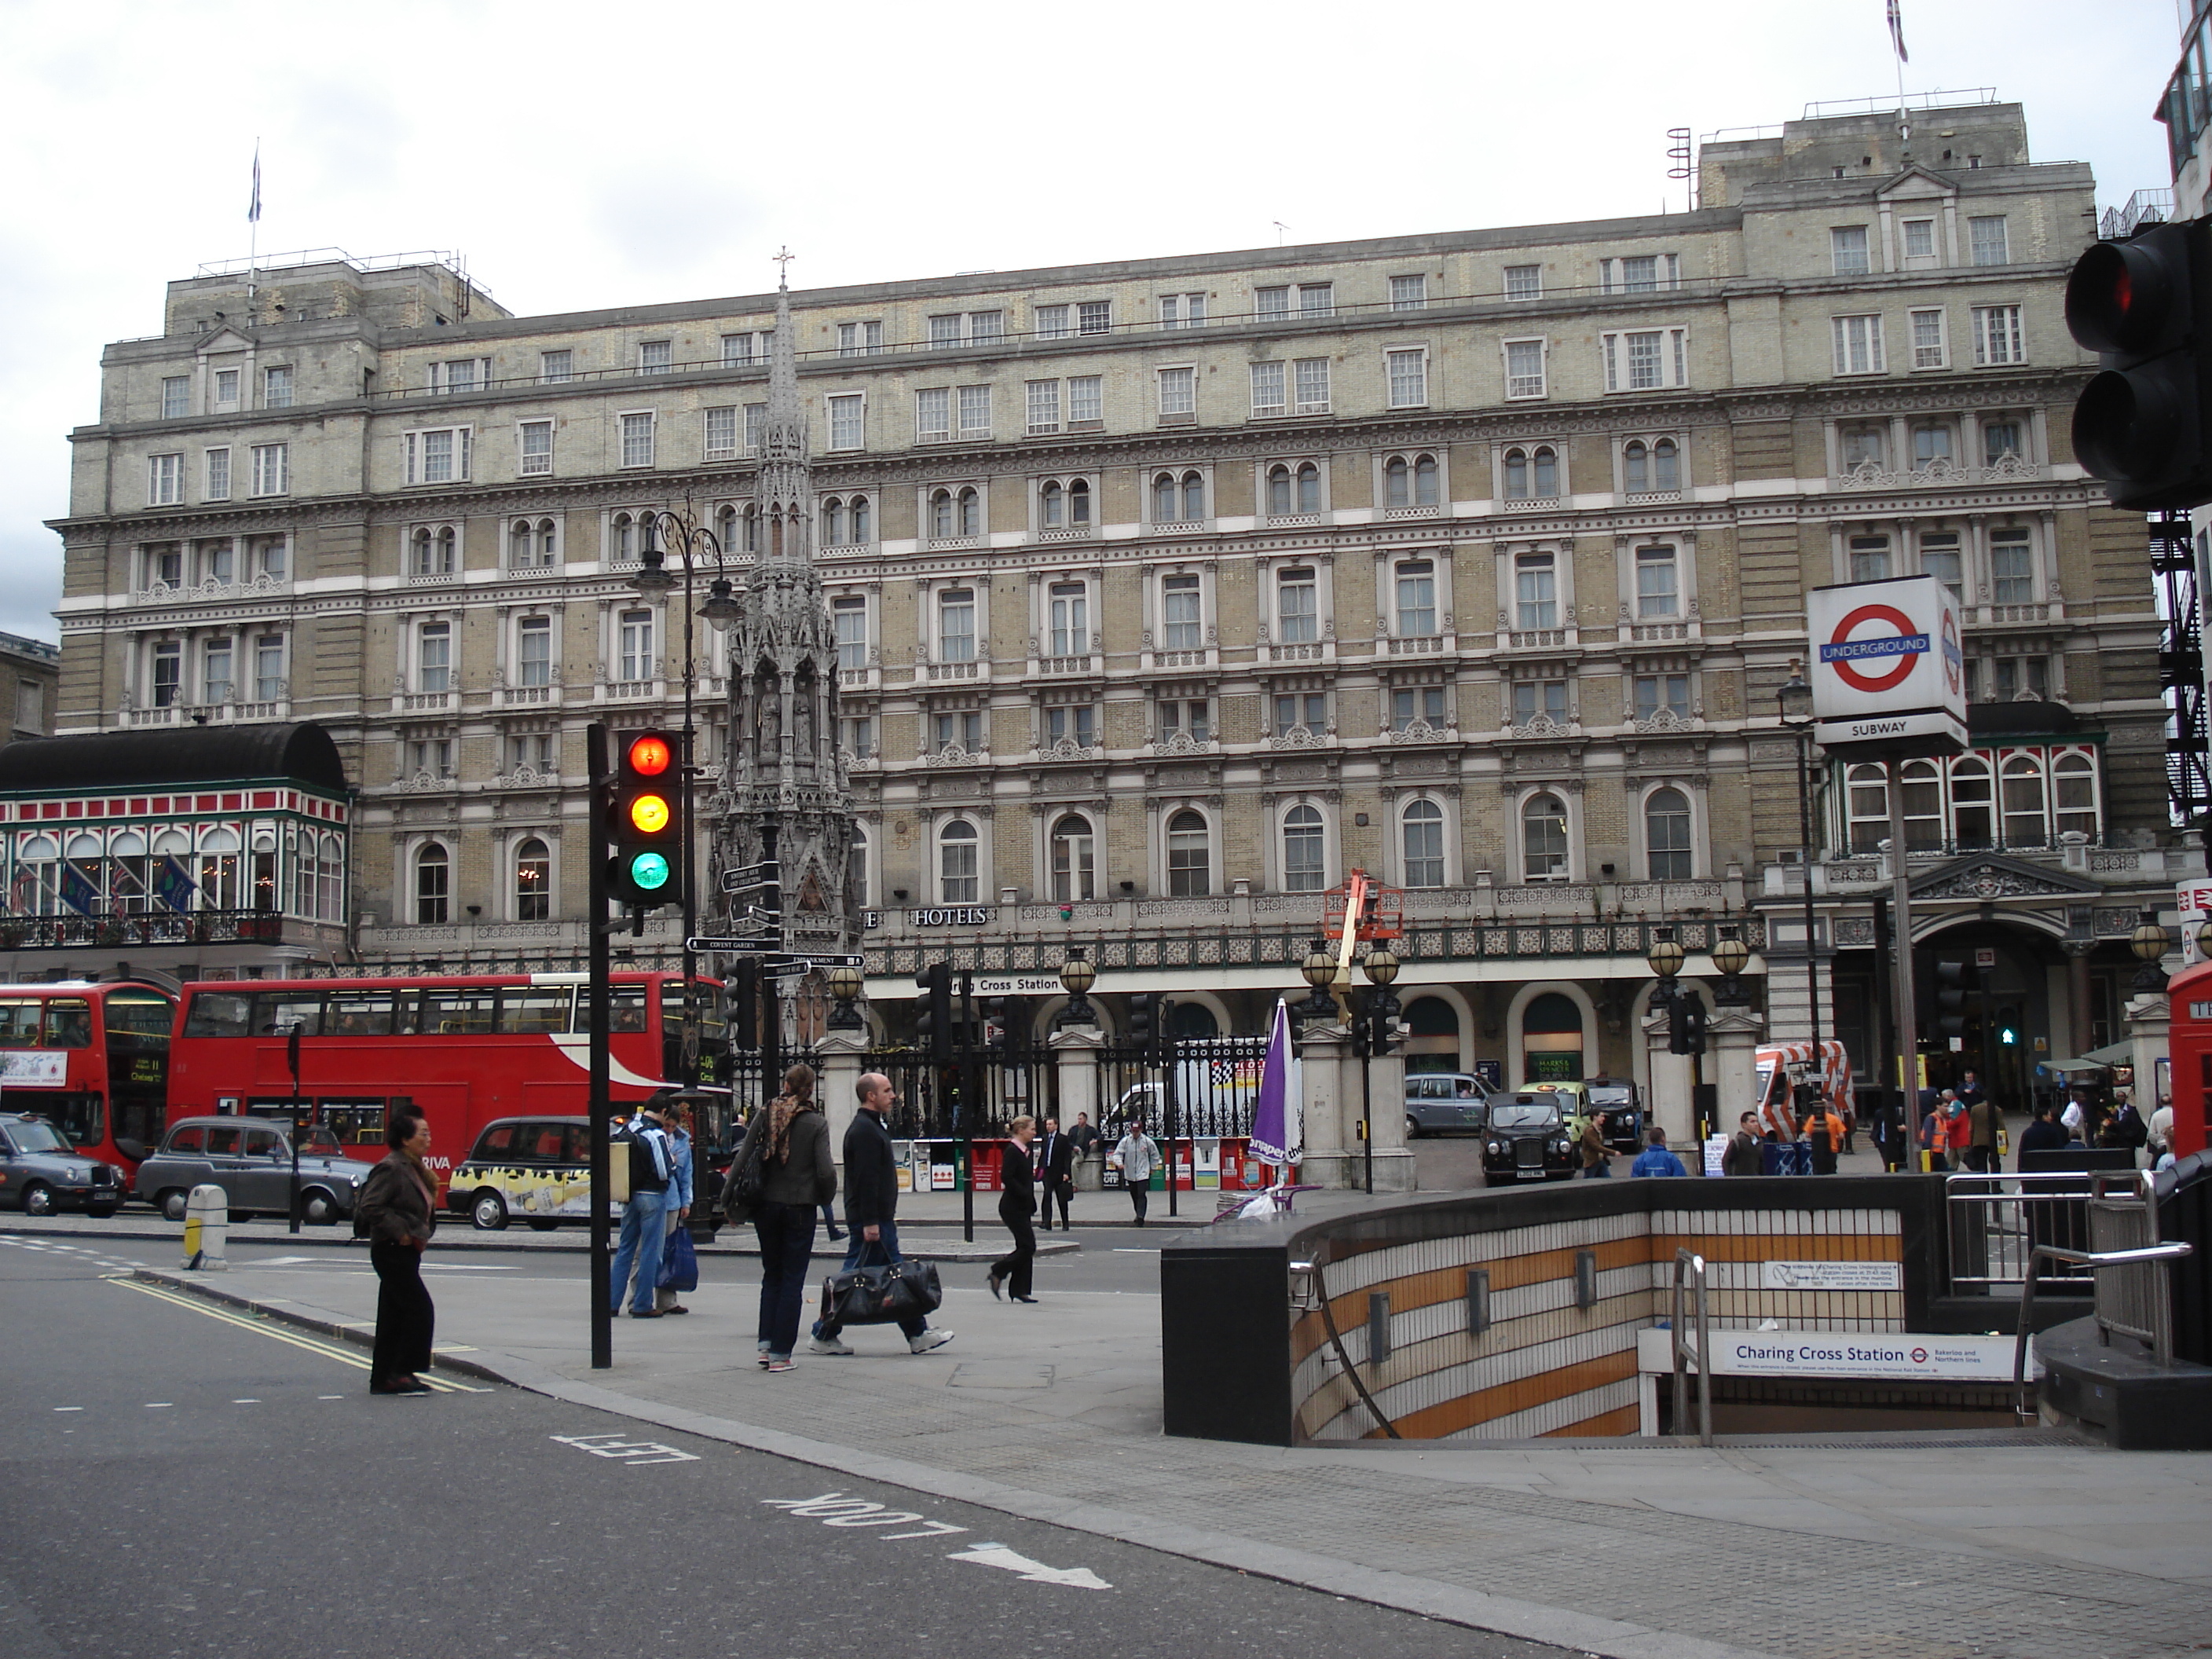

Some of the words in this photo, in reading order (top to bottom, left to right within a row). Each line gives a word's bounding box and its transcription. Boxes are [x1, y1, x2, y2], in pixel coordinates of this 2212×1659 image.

[1823, 639, 1927, 658] UNDERGROUND
[1852, 722, 1906, 736] SUBWAY
[915, 908, 987, 926] HOTELS
[980, 980, 1012, 991] Cross
[1017, 979, 1058, 990] Station
[1737, 1346, 1794, 1362] Charing
[1800, 1346, 1842, 1360] Cross
[1848, 1347, 1903, 1361] Station
[548, 1434, 701, 1465] LEFT
[760, 1492, 970, 1542] LOOK
